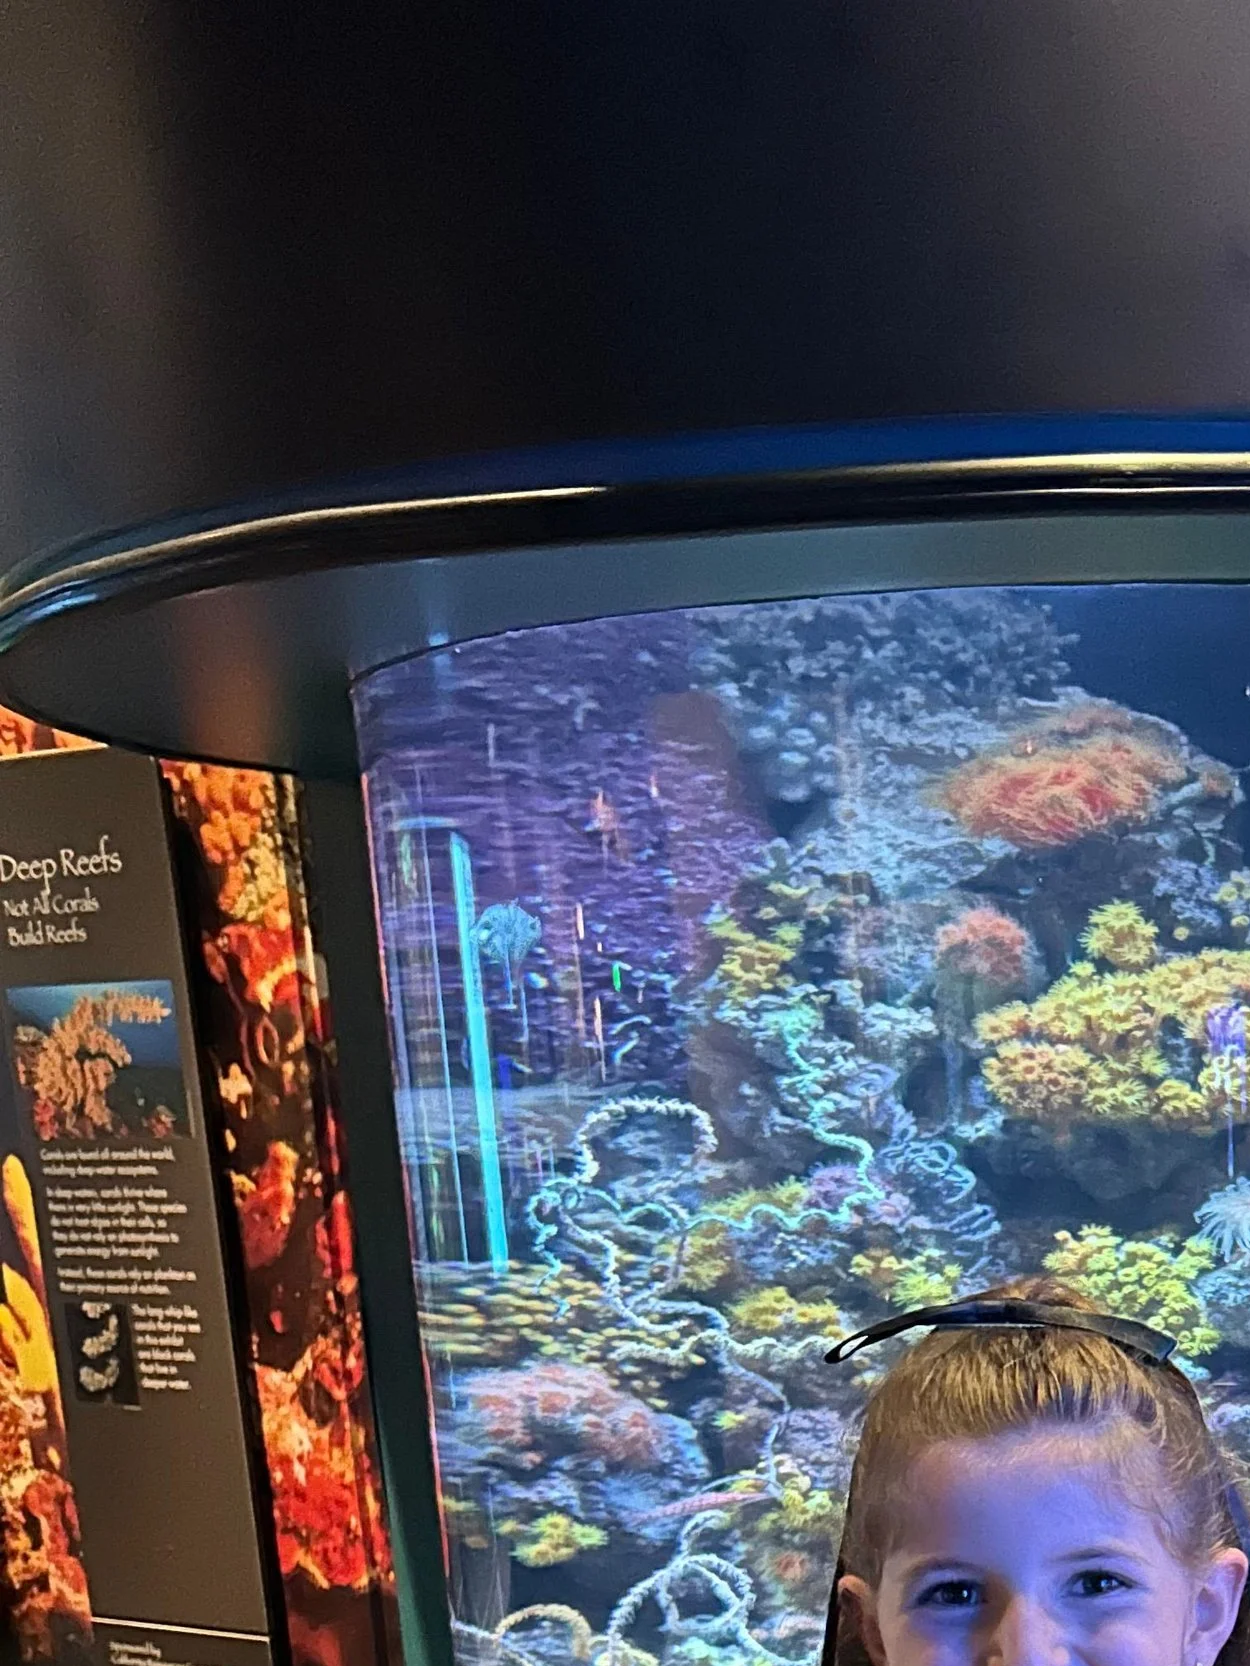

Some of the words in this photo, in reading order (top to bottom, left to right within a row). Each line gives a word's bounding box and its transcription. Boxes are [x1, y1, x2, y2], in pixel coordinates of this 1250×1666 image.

[0, 854, 57, 894] Deep
[60, 834, 122, 876] Reefs
[3, 899, 30, 917] Not
[52, 886, 99, 915] Corals
[8, 920, 44, 946] Build
[45, 916, 87, 944] Reefs
